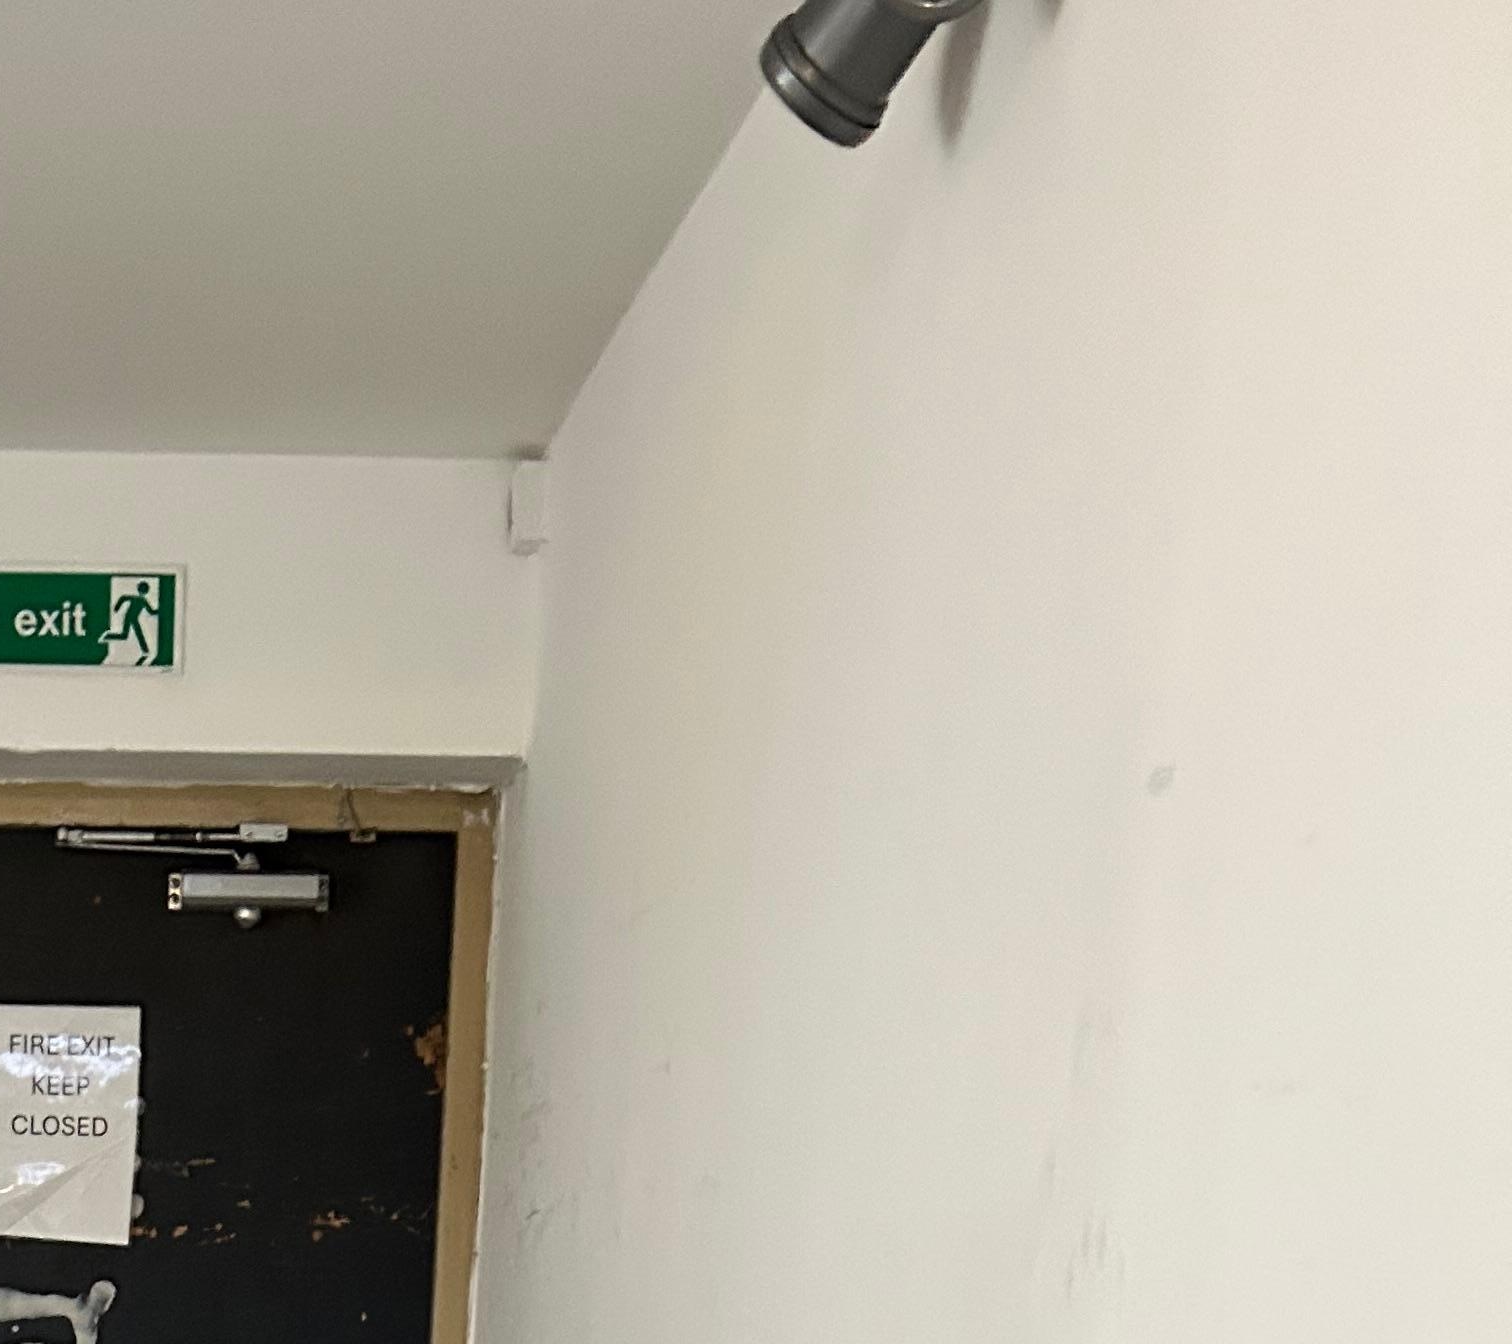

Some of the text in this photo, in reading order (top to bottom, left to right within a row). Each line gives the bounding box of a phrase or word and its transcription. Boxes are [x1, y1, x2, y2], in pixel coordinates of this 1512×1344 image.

[14, 600, 87, 637] exit
[9, 1033, 116, 1057] FIRE EXIT
[31, 1075, 90, 1096] KEEP
[11, 1114, 109, 1137] CLOSED
